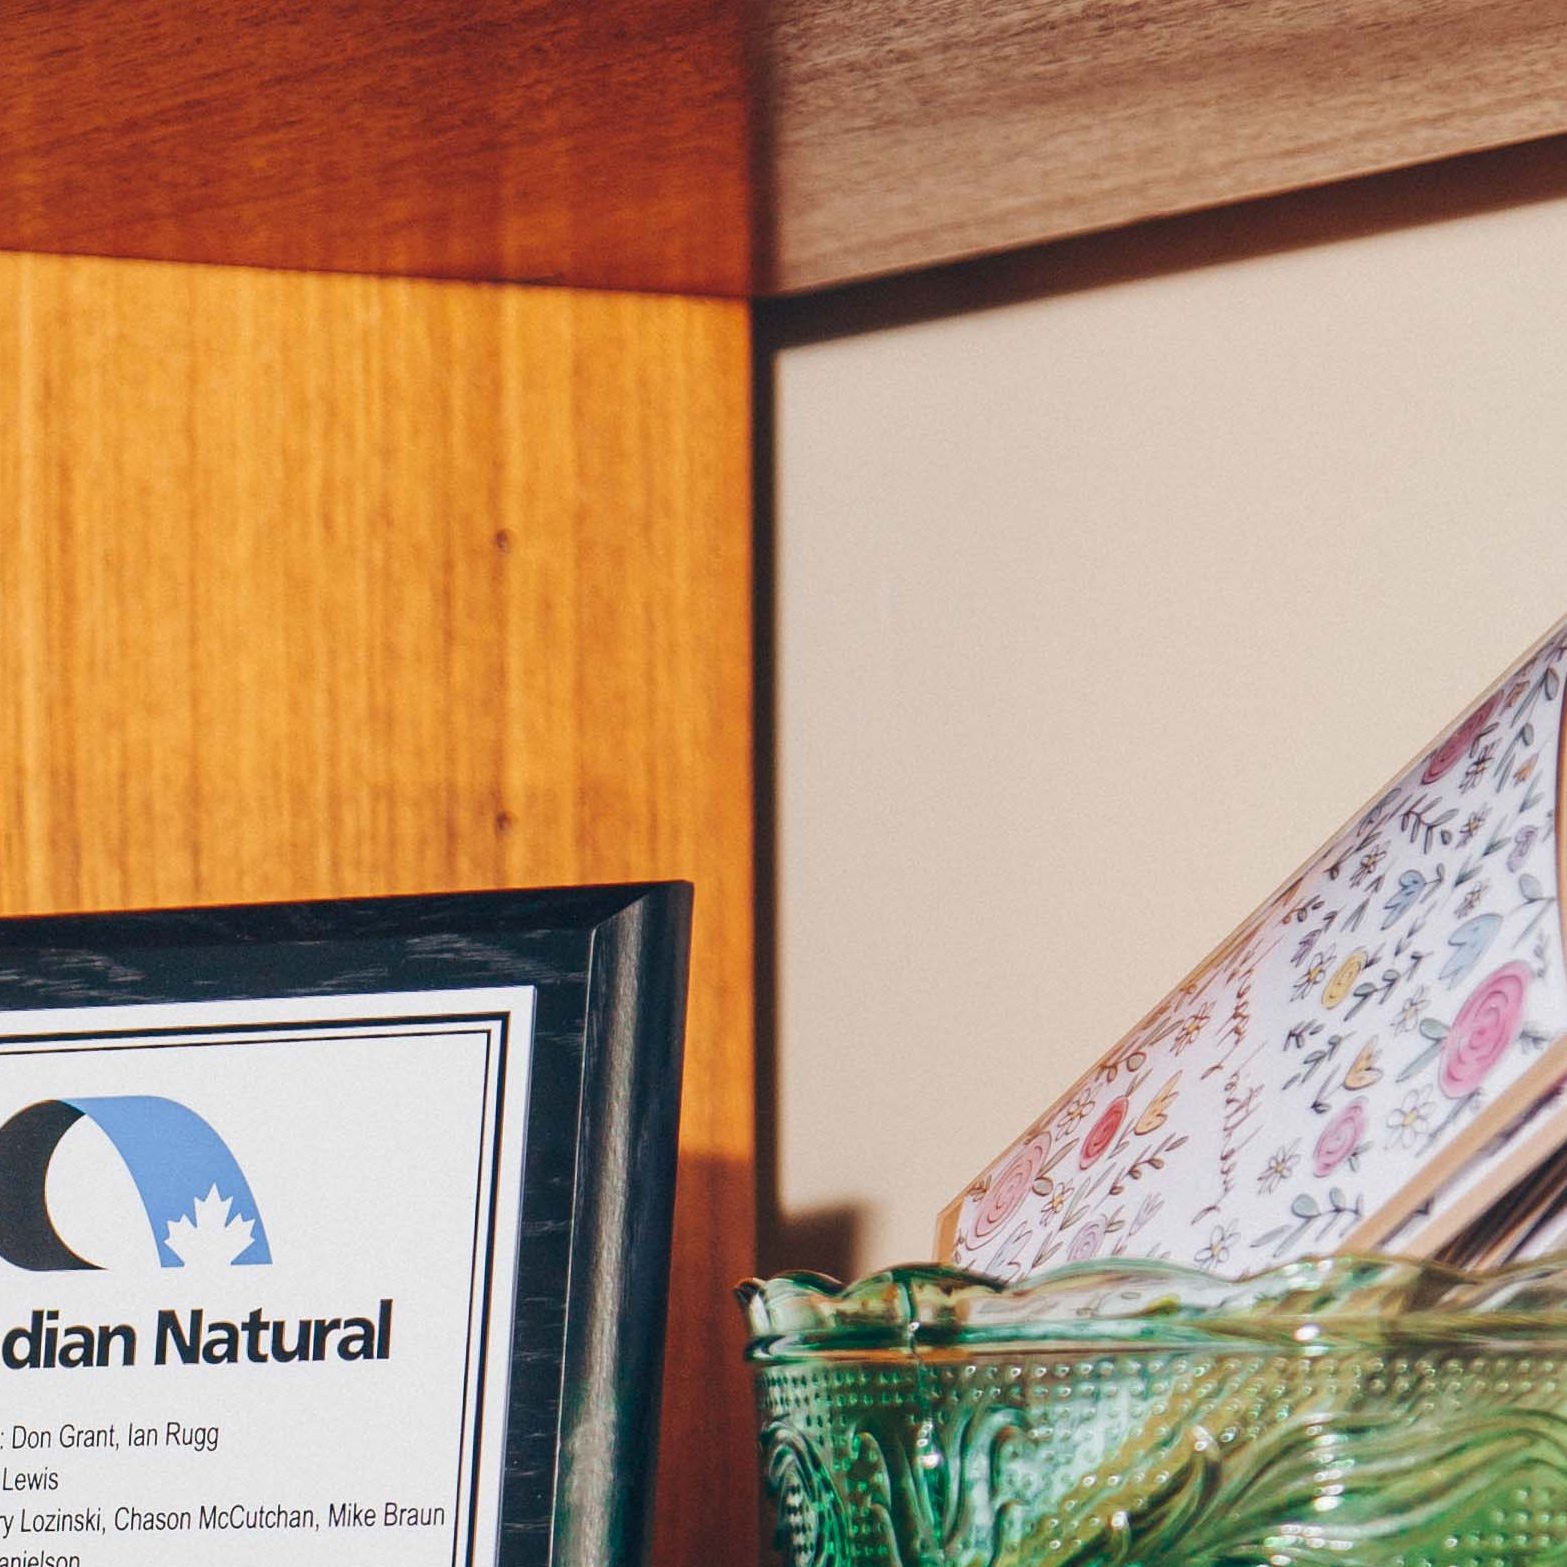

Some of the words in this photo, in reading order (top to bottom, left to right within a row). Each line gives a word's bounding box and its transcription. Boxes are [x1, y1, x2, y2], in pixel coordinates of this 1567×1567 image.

[155, 1300, 393, 1365] Natural
[11, 1424, 53, 1451] Don
[58, 1423, 120, 1452] Grant,
[127, 1421, 159, 1447] Ian
[164, 1420, 220, 1453] Rugg
[1, 1466, 60, 1492] Lewis
[19, 1506, 107, 1536] Lozinski,
[113, 1506, 193, 1532] Chason
[197, 1502, 321, 1533] McCutchan,
[327, 1501, 378, 1529] Mike
[382, 1501, 446, 1528] Braun
